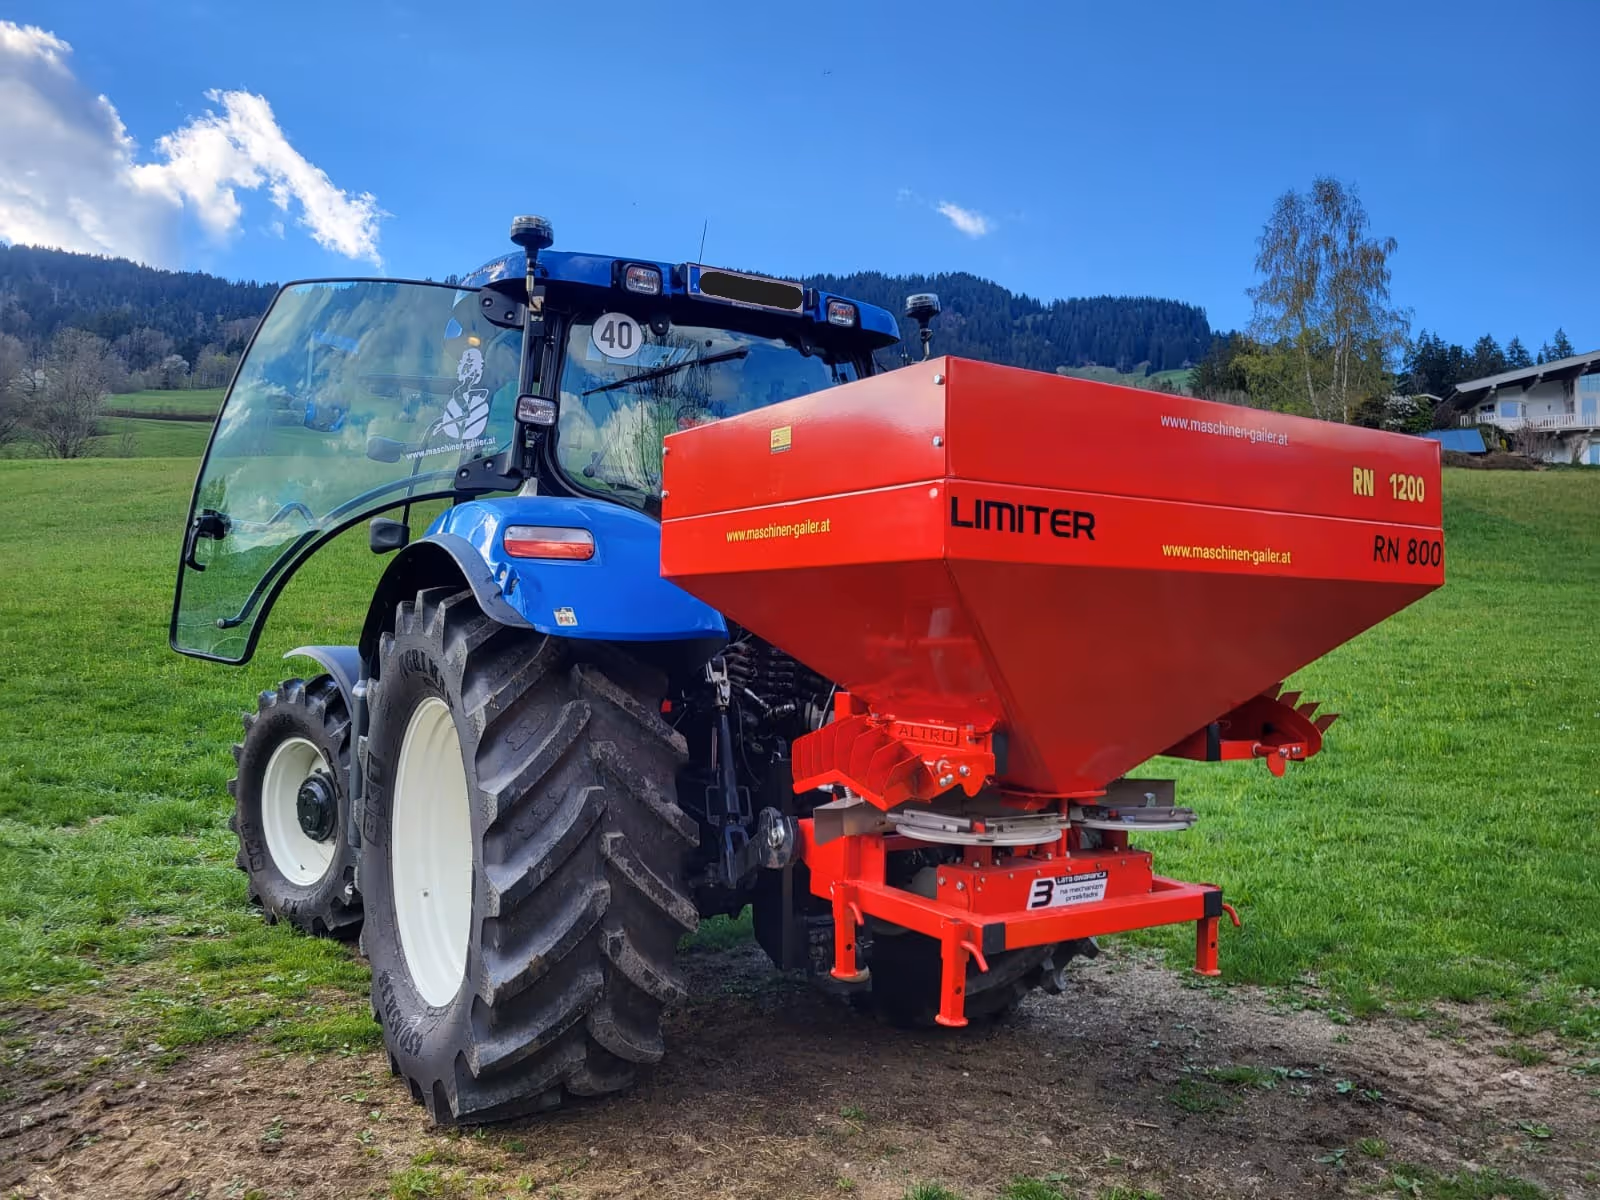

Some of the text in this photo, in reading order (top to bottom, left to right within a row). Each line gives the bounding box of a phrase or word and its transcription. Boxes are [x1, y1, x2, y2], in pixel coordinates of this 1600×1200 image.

[600, 320, 633, 350] 40
[1160, 415, 1289, 446] www.maschinen-gailer.at
[406, 436, 496, 460] www.maschinen-gailer.at
[1352, 466, 1425, 503] RN 1200
[726, 518, 831, 543] www.maschinen-gailer.at
[951, 496, 1096, 541] LIMITER
[1162, 544, 1291, 566] www.maschinen-gailer.at
[1373, 534, 1442, 568] RN 800
[898, 724, 955, 743] ALTRO
[1031, 879, 1054, 909] 3
